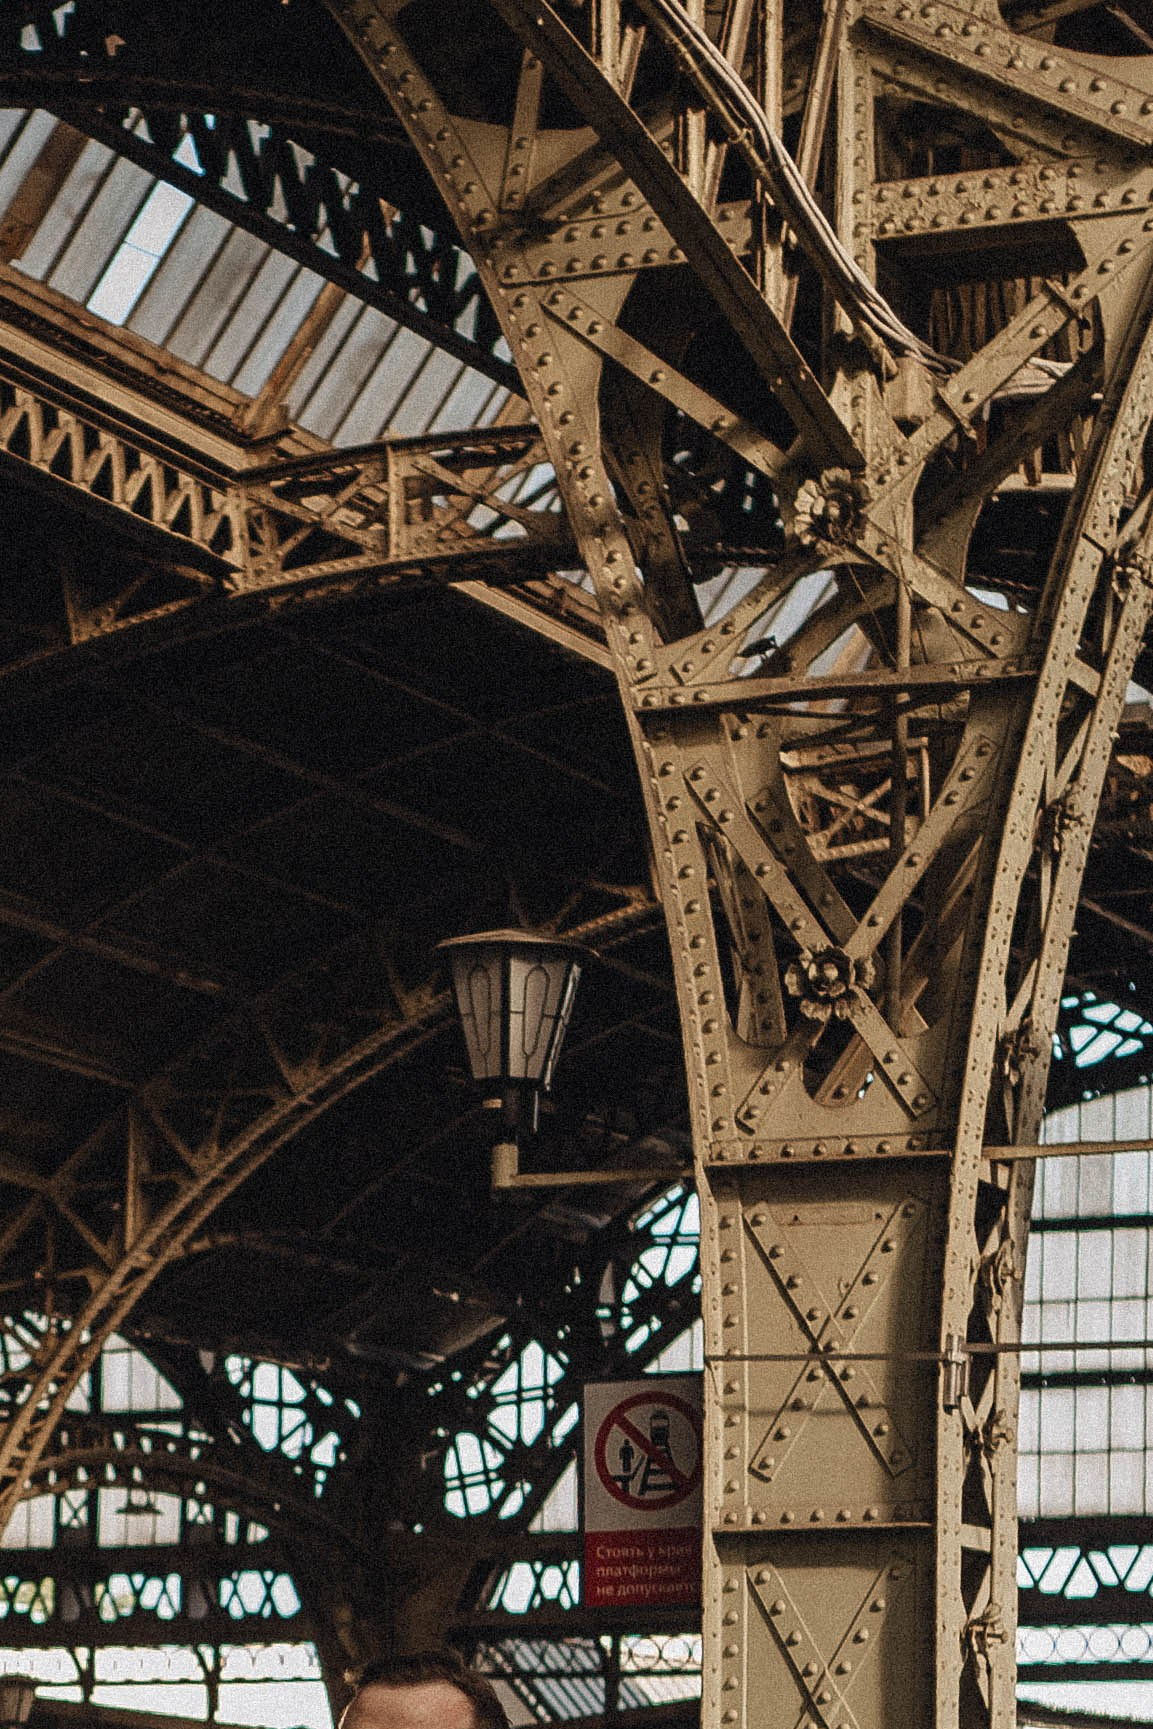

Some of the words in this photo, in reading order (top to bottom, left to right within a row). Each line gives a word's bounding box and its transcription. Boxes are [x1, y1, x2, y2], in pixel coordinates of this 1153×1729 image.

[595, 1545, 645, 1559] Стоять
[595, 1585, 615, 1597] не
[617, 1583, 696, 1599] допускаетс
